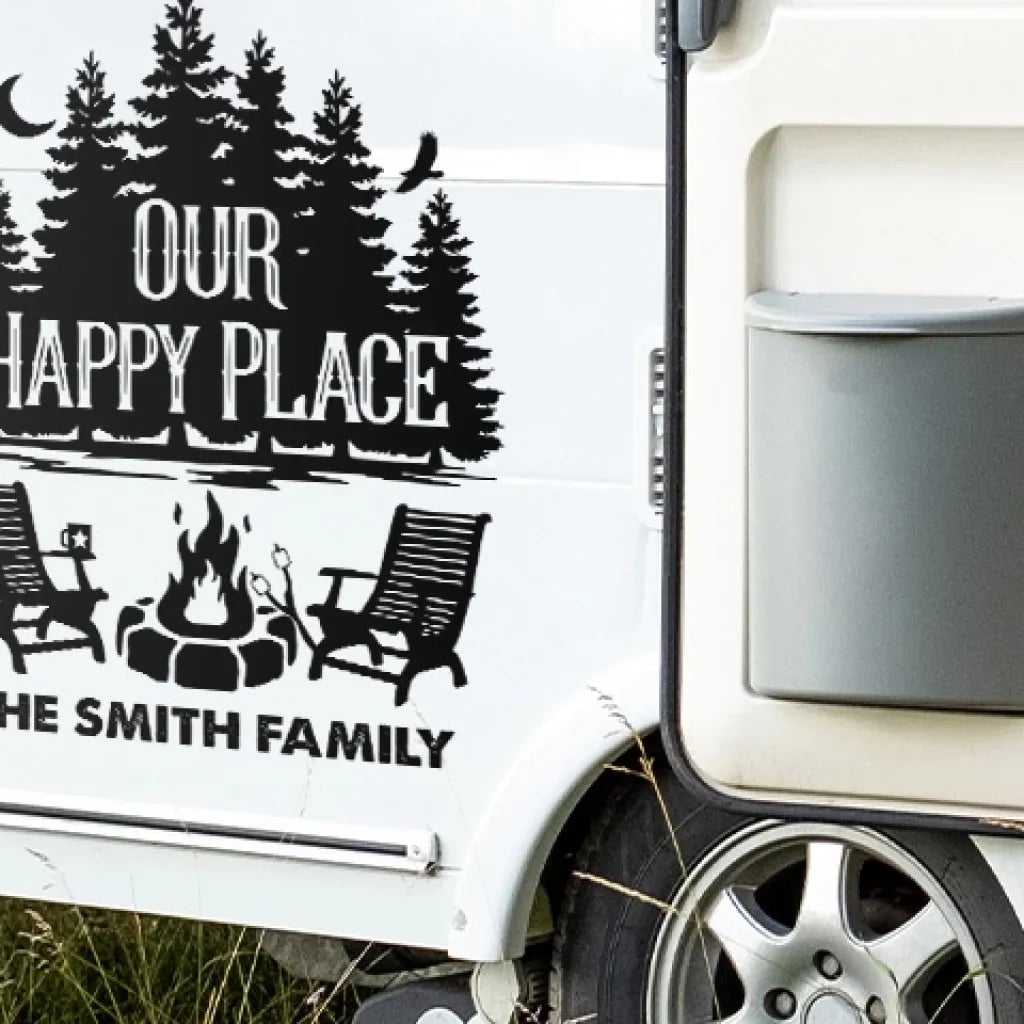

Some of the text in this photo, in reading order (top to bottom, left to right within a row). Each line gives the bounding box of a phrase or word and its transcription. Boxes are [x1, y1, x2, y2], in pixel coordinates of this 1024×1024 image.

[134, 198, 288, 310] OUR
[222, 321, 450, 428] PLACE
[75, 697, 240, 750] SMITH
[256, 715, 455, 769] FAMILY
